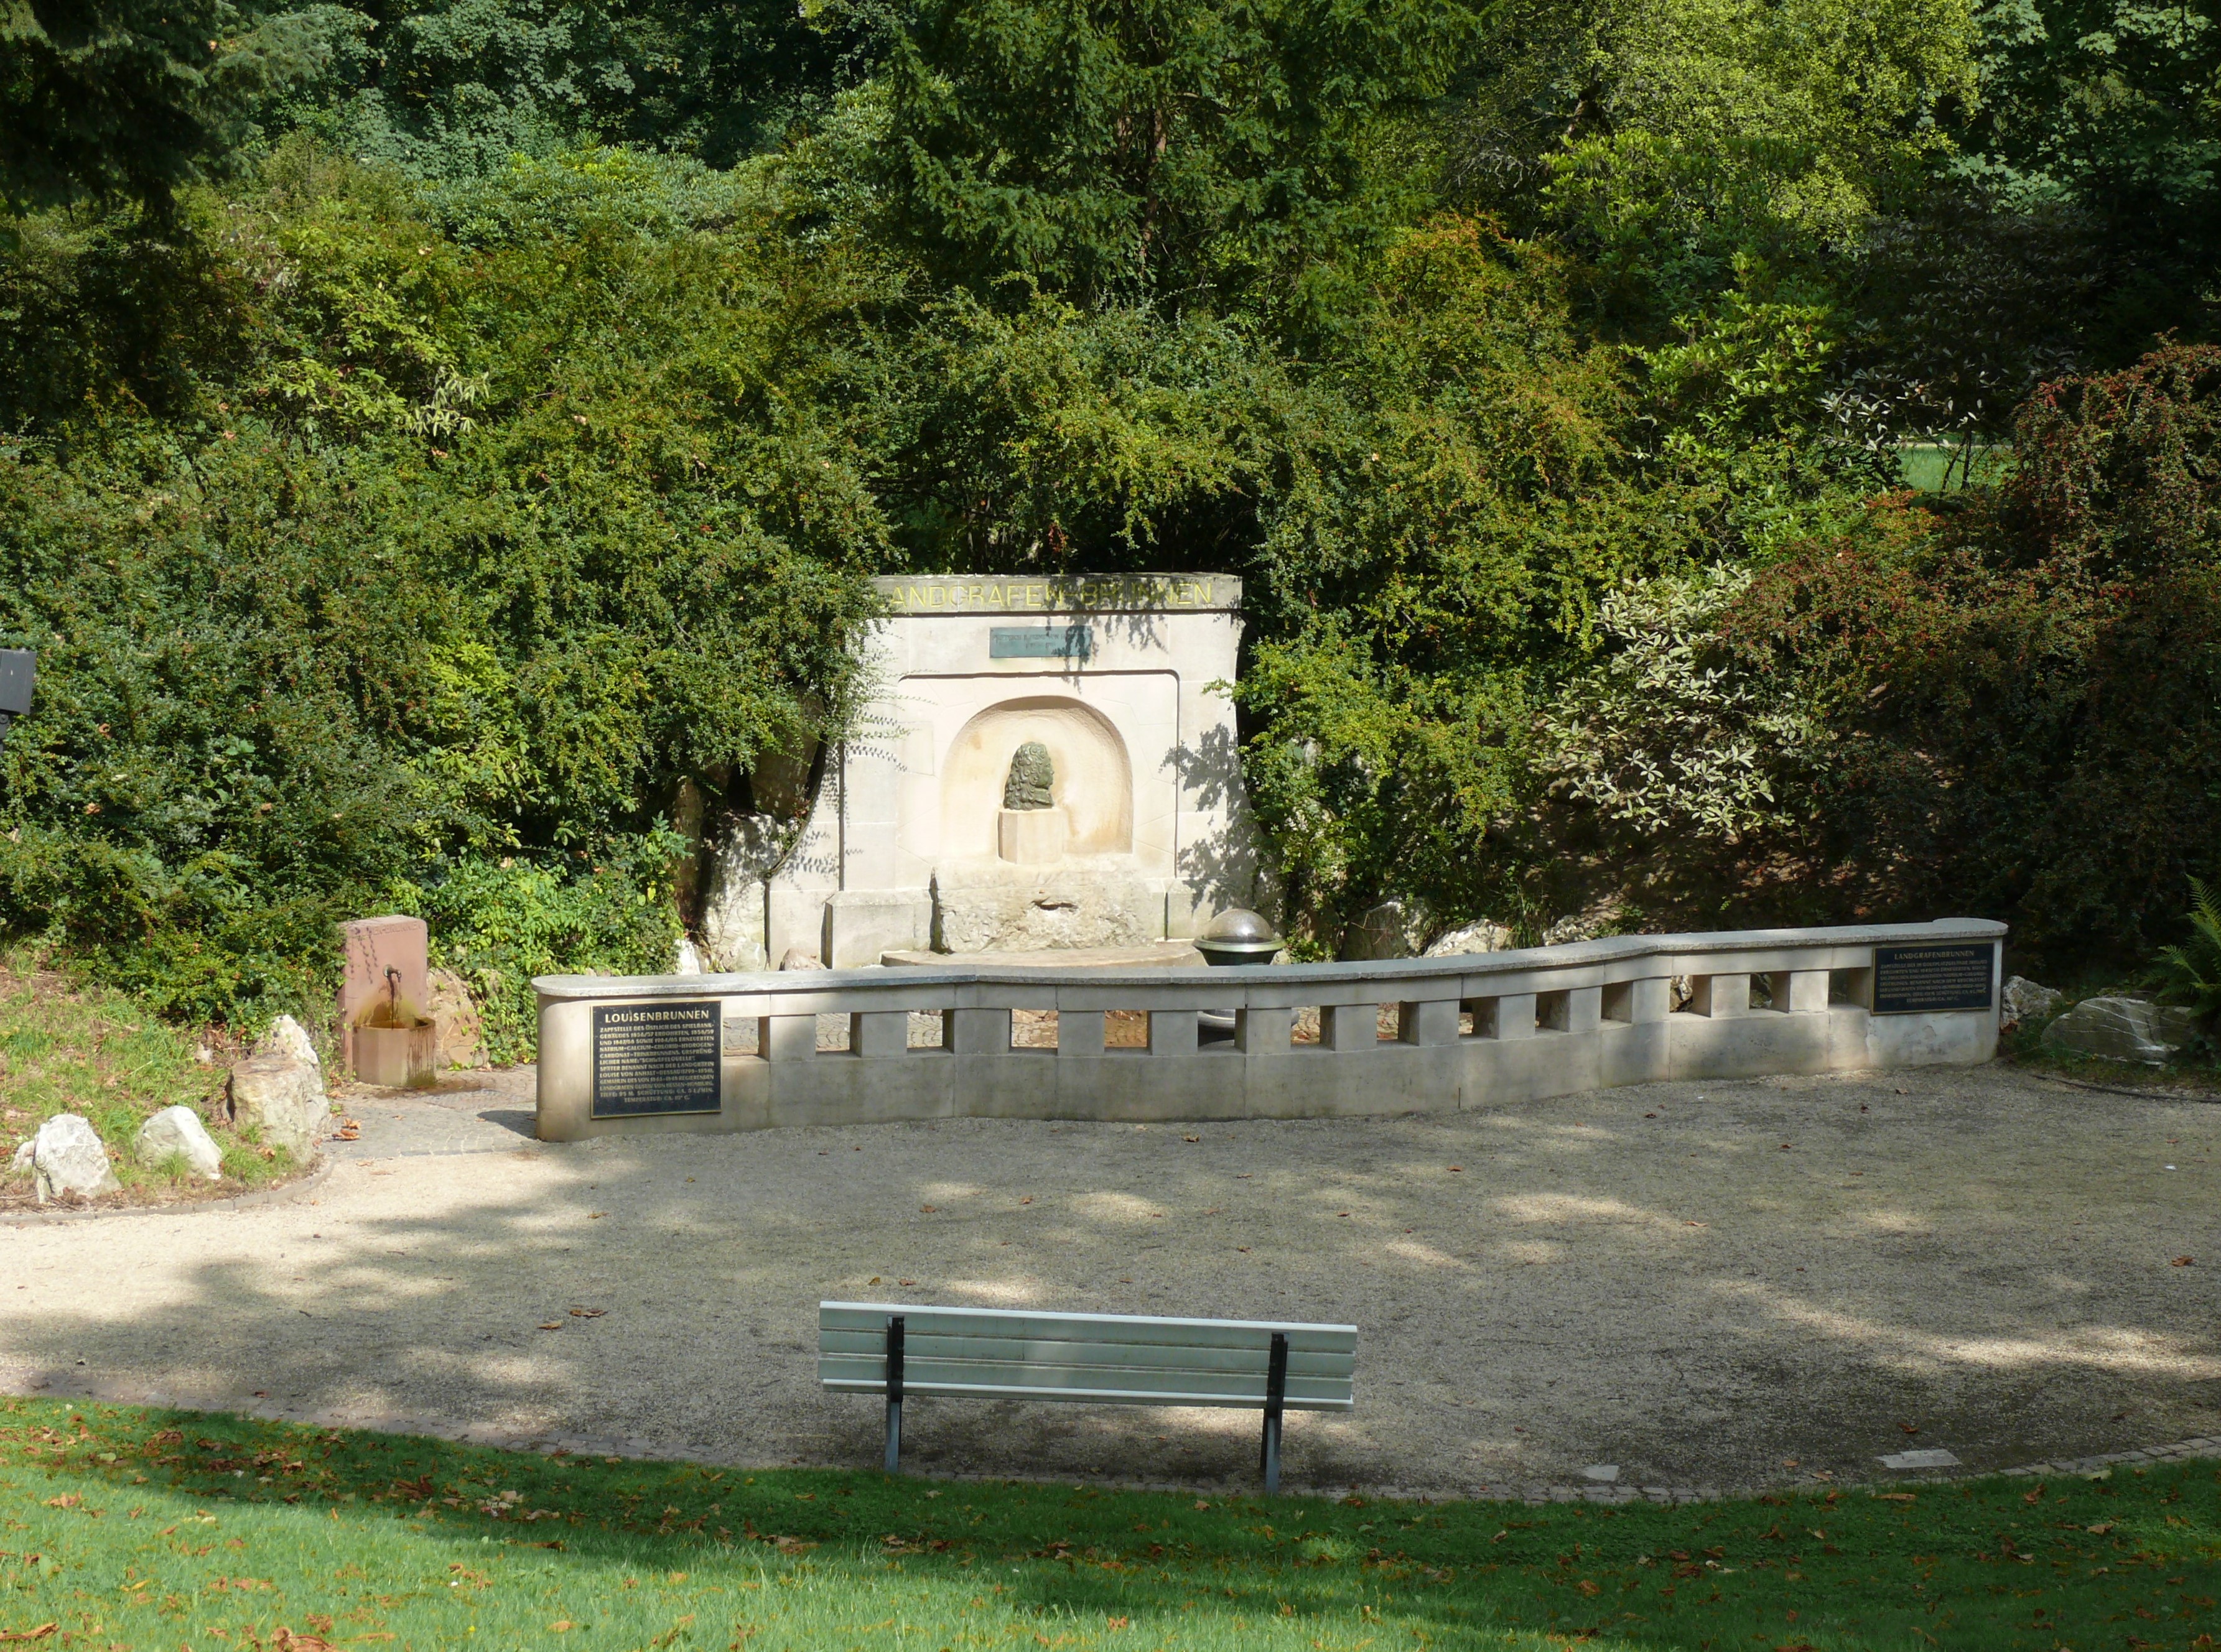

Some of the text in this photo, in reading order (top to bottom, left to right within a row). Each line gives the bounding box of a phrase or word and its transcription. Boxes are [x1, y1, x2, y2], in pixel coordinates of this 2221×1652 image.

[871, 582, 1212, 609] ANDGRAFEN-BRUNNEN
[1894, 949, 1974, 960] LANDGRAFENBRUNNEN
[605, 1009, 709, 1023] LOUISENBRUNNEN
